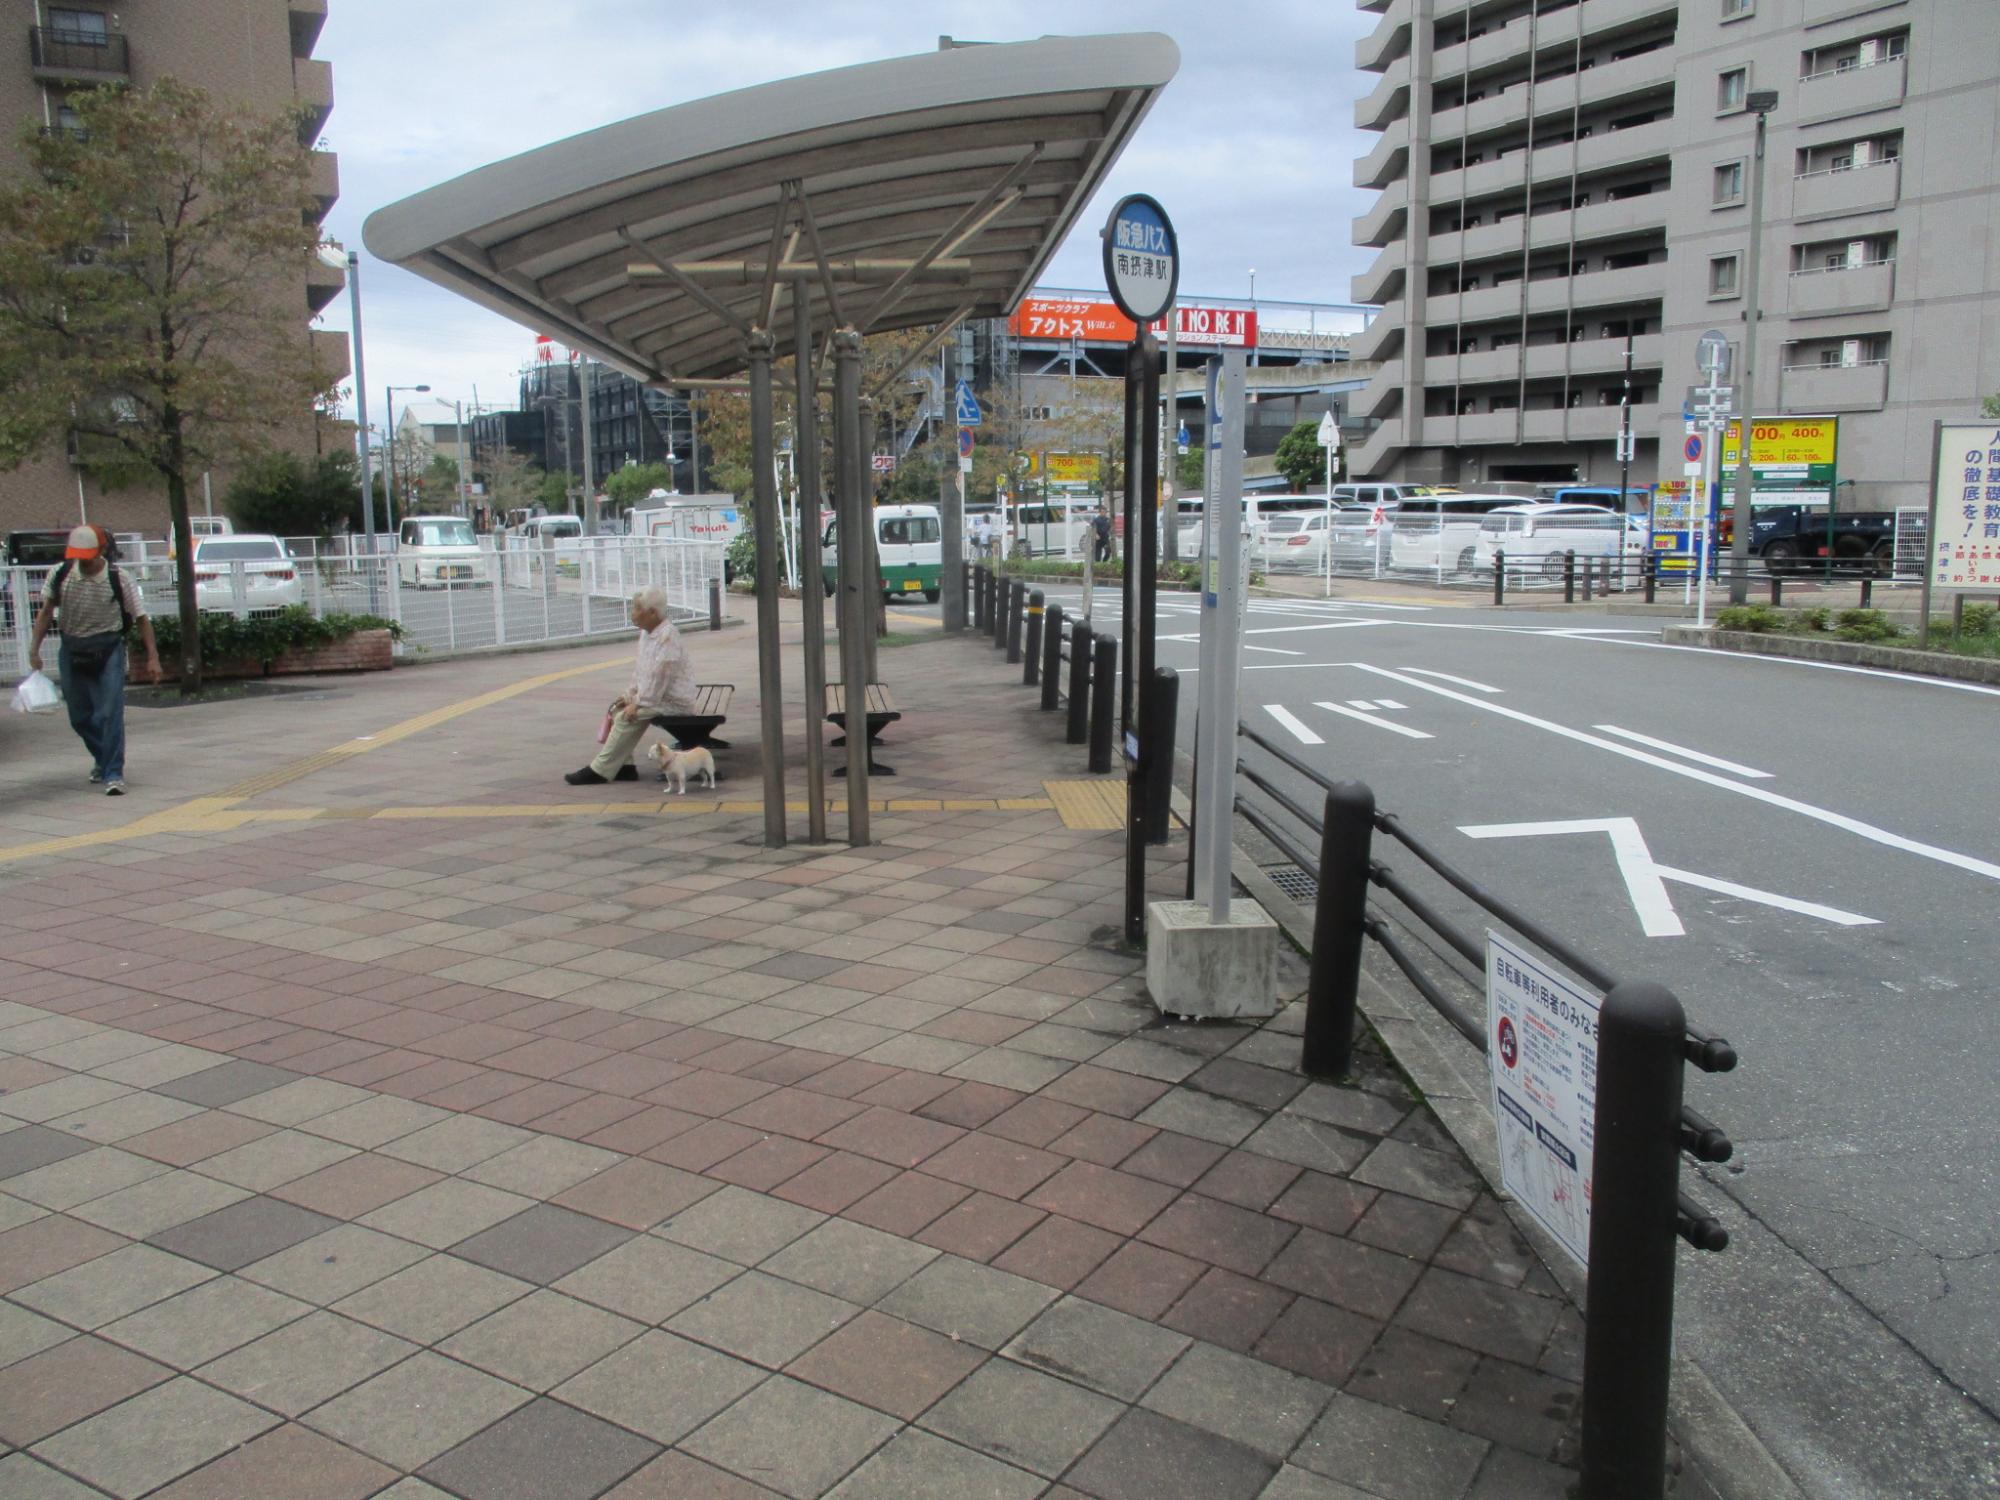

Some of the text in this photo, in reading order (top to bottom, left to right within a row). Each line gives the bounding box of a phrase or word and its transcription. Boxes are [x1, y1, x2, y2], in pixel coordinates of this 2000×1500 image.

[1117, 219, 1166, 253] 阪急バス
[1117, 254, 1167, 280] 南摂津駅
[1030, 302, 1090, 314] スポーツクラブ
[1029, 317, 1085, 336] アクトス
[689, 524, 729, 533] Yakult
